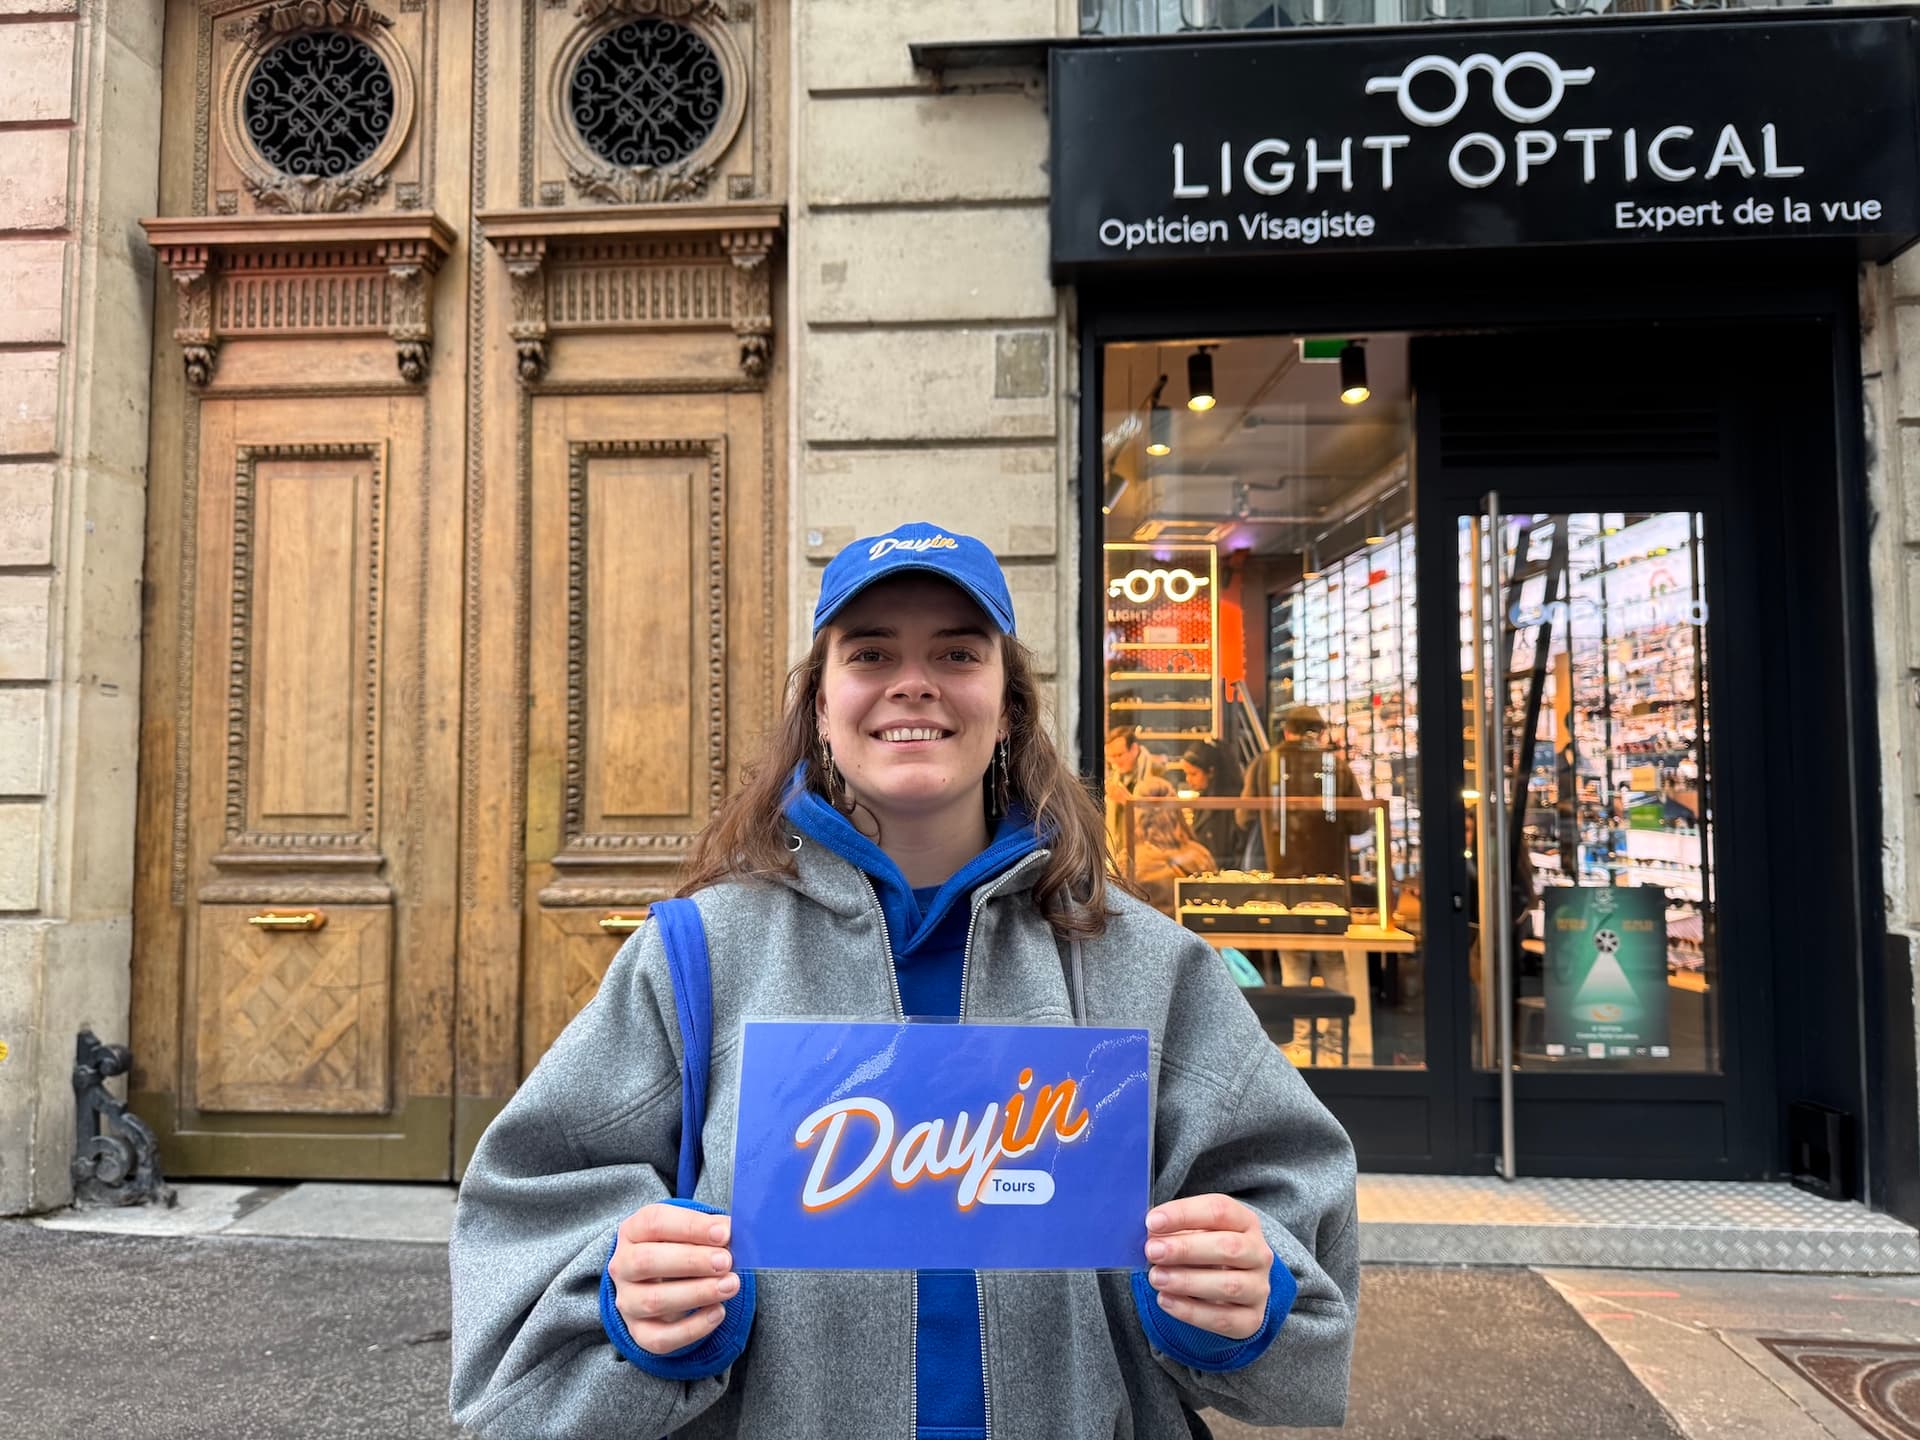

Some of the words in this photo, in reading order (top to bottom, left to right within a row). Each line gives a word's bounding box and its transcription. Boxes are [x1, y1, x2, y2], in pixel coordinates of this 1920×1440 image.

[1172, 134, 1411, 198] LIGHT
[1448, 122, 1805, 190] OPTICAL
[1099, 215, 1229, 251] Opticien
[1238, 209, 1376, 244] Visagiste
[1615, 200, 1724, 232] Expert
[1732, 197, 1775, 224] de
[1784, 196, 1812, 223] la
[1820, 199, 1882, 222] vue
[868, 533, 959, 562] Dayin
[1107, 608, 1148, 622] LIGHT
[795, 1066, 1090, 1213] Dayin
[992, 1178, 1036, 1193] Tours
